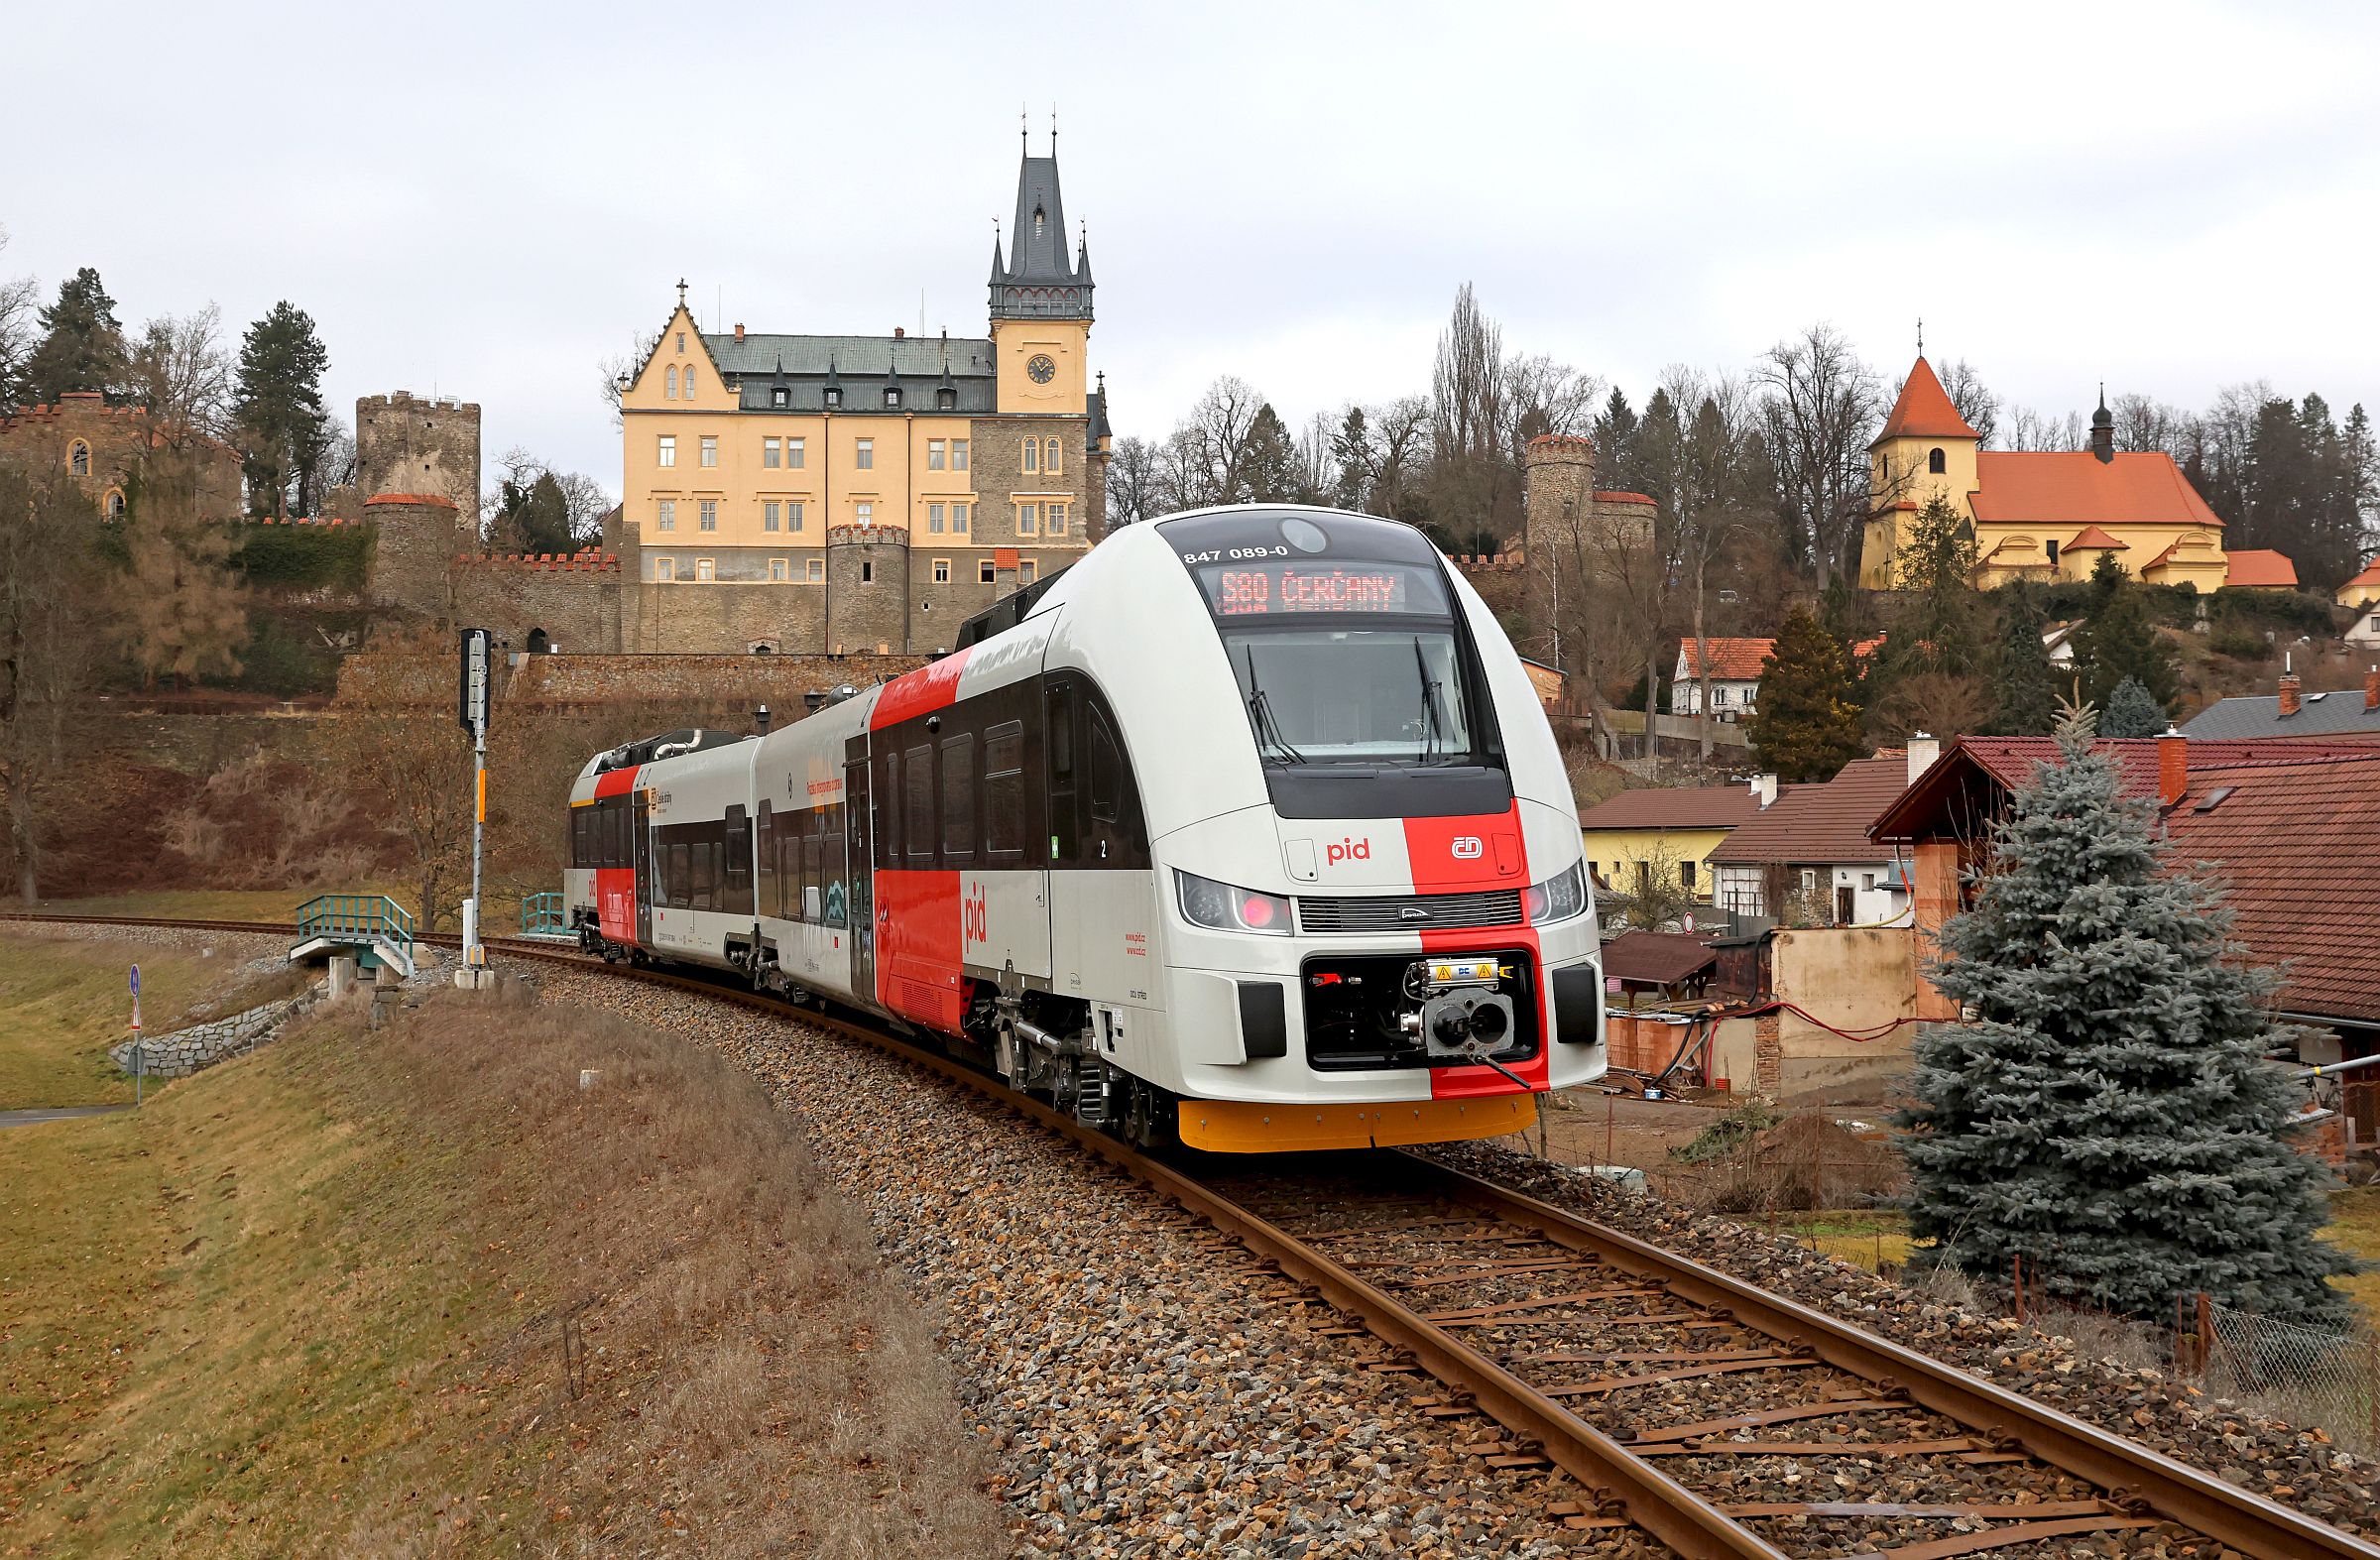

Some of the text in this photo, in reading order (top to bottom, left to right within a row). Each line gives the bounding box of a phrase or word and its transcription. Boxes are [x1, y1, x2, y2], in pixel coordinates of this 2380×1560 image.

[1184, 545, 1288, 564] 847 089-0
[1222, 569, 1394, 602] S80 ČERČANY
[1101, 839, 1107, 858] 2
[1327, 837, 1370, 866] pid
[965, 881, 986, 954] pid
